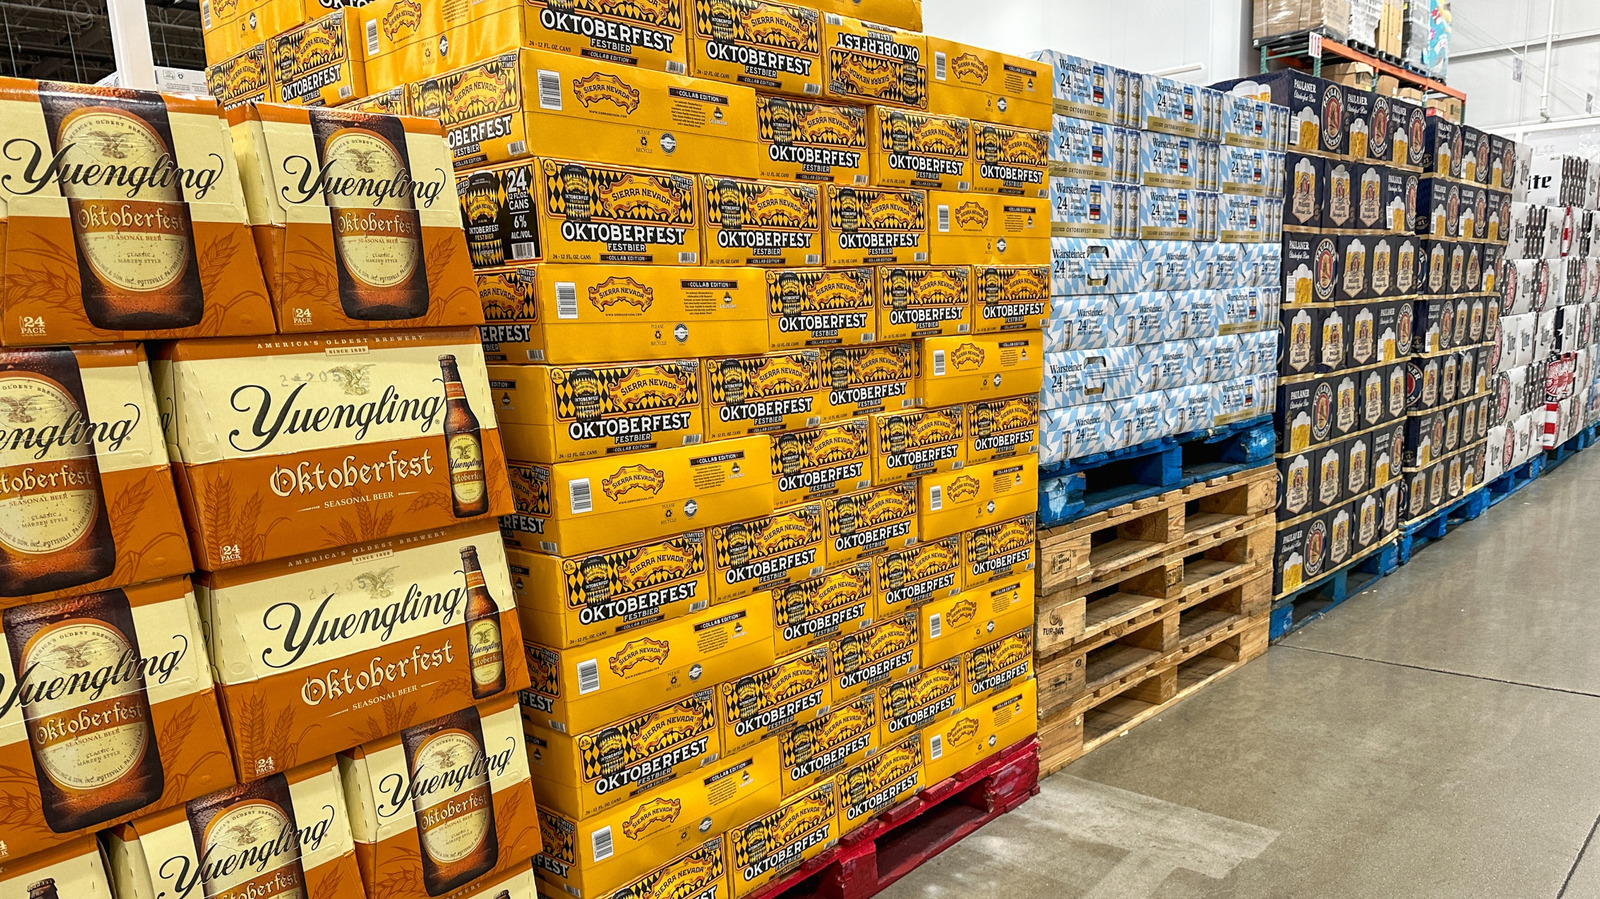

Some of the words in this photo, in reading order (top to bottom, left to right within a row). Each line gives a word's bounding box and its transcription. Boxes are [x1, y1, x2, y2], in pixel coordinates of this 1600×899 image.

[540, 9, 675, 54] OKTOBERFEST
[590, 38, 632, 54] FESTBIER
[706, 41, 812, 76] OKTOBERFEST
[1059, 59, 1091, 76] Warsteiner
[744, 65, 777, 78] FESTBIER
[281, 65, 342, 103] OKTOBERFEST
[1060, 74, 1071, 88] 24
[1156, 81, 1182, 94] Warsteiner
[1294, 79, 1317, 94] PAULANER
[583, 84, 606, 94] SIERRA
[606, 84, 631, 100] NEVADA
[679, 90, 699, 99] COLLAB
[700, 93, 720, 102] EDITION
[1157, 93, 1167, 106] 24
[447, 115, 512, 149] OBERFEST
[1059, 122, 1090, 136] Warsteiner
[1059, 135, 1070, 149] 24
[1153, 137, 1179, 150] Warsteiner
[769, 144, 861, 169] OKTOBERFEST
[888, 153, 964, 176] OKTOBERFEST
[1154, 150, 1163, 162] 24
[1, 138, 224, 200] Yuengling
[802, 163, 830, 173] FESTBIER
[980, 163, 1043, 185] OKTOBERFEST
[282, 155, 447, 208] Yuengling
[507, 168, 527, 193] 24
[671, 174, 693, 186] LIMITED
[1056, 182, 1088, 196] Warsteiner
[1527, 174, 1552, 193] ite
[509, 199, 530, 210] CANS
[611, 188, 640, 201] SIERRA
[641, 188, 674, 207] NEVADA
[1057, 196, 1068, 209] 24
[1151, 191, 1177, 202] Warsteiner
[78, 205, 186, 231] Oktoberfest
[1151, 204, 1161, 216] 24
[337, 211, 416, 235] Oktoberfest
[513, 215, 527, 228] 6%
[561, 222, 686, 245] OKTOBERFEST
[718, 230, 812, 248] OKTOBERFEST
[839, 232, 920, 249] OKTOBERFEST
[607, 243, 647, 252] FESTBIER
[752, 248, 781, 256] FESTBIER
[1052, 249, 1086, 259] Warsteiner
[1288, 240, 1310, 250] PAULANER
[516, 268, 536, 278] LIMITED
[1054, 260, 1066, 273] 24
[1166, 263, 1175, 273] 24
[492, 288, 516, 302] NEVADA
[296, 308, 311, 318] 24
[889, 306, 964, 324] OKTOBERFEST
[982, 302, 1045, 319] OKTOBERFEST
[1077, 307, 1103, 317] Warsteiner
[24, 316, 45, 327] 24
[779, 313, 868, 332] OKTOBERFEST
[1077, 319, 1088, 331] 24
[1139, 315, 1148, 325] 24
[257, 340, 319, 349] AMERICA'S
[1050, 363, 1082, 375] Warsteiner
[620, 379, 647, 397] SIERRA
[649, 378, 679, 391] NEVADA
[1052, 375, 1063, 388] 24
[829, 381, 907, 406] OKTOBERFEST
[228, 378, 447, 453] Yuengling
[719, 397, 813, 422] OKTOBERFEST
[569, 412, 691, 440] OKTOBERFEST
[754, 415, 783, 425] FESTBIER
[1075, 416, 1101, 427] Warsteiner
[0, 403, 140, 459] engling
[614, 433, 652, 444] FESTBIER
[1076, 429, 1086, 439] 24
[450, 458, 482, 470] Yuengling
[886, 444, 959, 469] OKTOBERFEST
[0, 465, 92, 494] toberfest
[270, 448, 434, 497] Oktoberfest
[778, 462, 864, 493] OKTOBERFEST
[9, 497, 48, 507] SEASONAL
[324, 496, 371, 509] SEASONAL
[373, 491, 394, 501] BEER
[834, 521, 911, 551] OKTOBERFEST
[221, 552, 241, 562] PACK
[222, 544, 240, 555] 24
[288, 551, 347, 567] AMERICA'S
[352, 541, 394, 553] OLDEST
[629, 558, 656, 577] SIERRA
[657, 554, 685, 564] NEVADA
[725, 549, 817, 585] OKTOBERFEST
[885, 573, 955, 604] OKTOBERFEST
[579, 580, 697, 625] OKTOBERFEST
[262, 570, 467, 669] Yuengling
[623, 607, 660, 622] FESTBIER
[783, 603, 866, 641] OKTOBERFEST
[0, 634, 188, 722] Yuengling
[301, 639, 455, 706] Oktoberfest
[839, 651, 913, 689] OKTOBERFEST
[352, 691, 396, 711] SEASONAL
[398, 685, 418, 696] BEER
[36, 701, 143, 745] Oktoberfest
[734, 690, 824, 738] OKTOBERFEST
[888, 695, 956, 733] OKTOBERFEST
[641, 724, 666, 742] SIERRA
[667, 716, 696, 726] NEVADA
[65, 736, 101, 748] SEASONAL
[257, 756, 274, 767] 24
[595, 737, 708, 795] OKTOBERFEST
[790, 734, 871, 781] OKTOBERFEST
[377, 736, 516, 818] Yuengling
[637, 767, 672, 787] FESTBIER
[421, 792, 488, 830] Oktoberfest
[159, 804, 335, 899] Yuengling
[744, 825, 830, 882] OKTOBERFEST
[223, 870, 298, 899] toberfest
